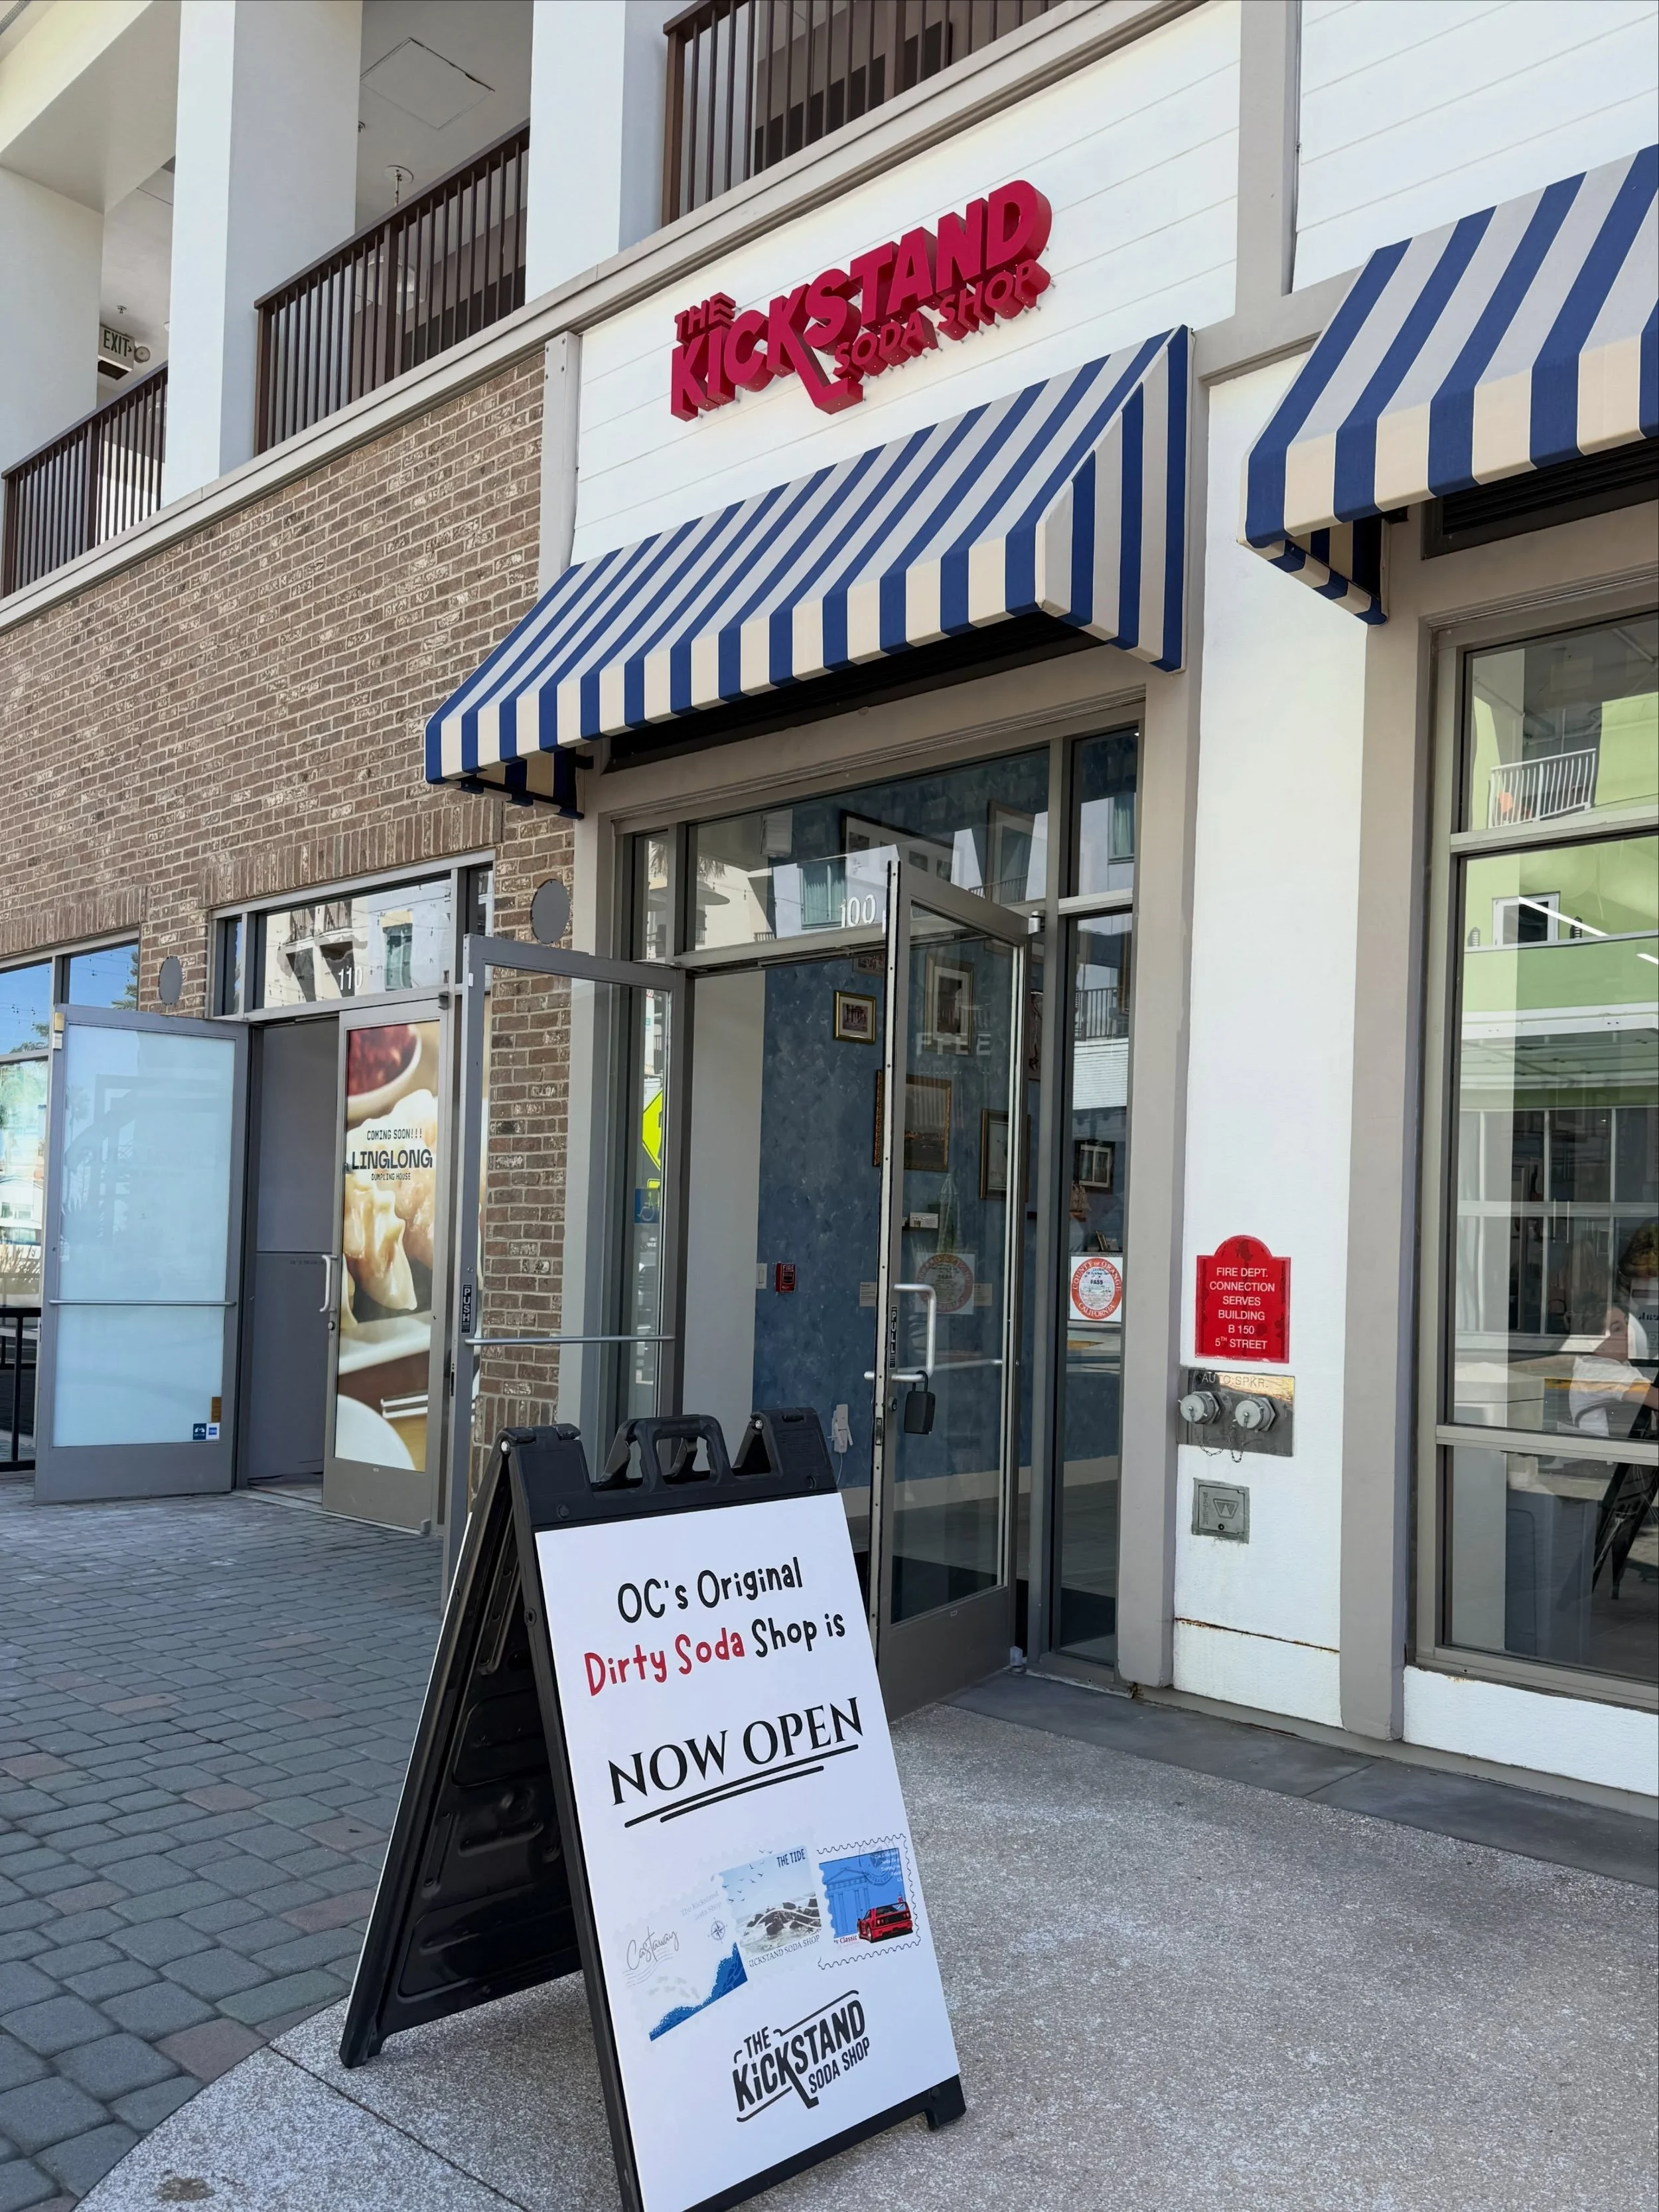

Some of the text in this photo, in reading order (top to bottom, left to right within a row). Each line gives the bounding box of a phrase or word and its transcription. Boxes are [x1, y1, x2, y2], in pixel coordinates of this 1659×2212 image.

[671, 180, 1052, 421] KICKSTAND
[674, 292, 736, 343] THE
[833, 259, 1051, 381] SODA SHOP
[104, 329, 130, 357] EXIT
[839, 894, 876, 928] 100
[338, 966, 363, 991] 110
[367, 1128, 422, 1140] COMING SOON!!!
[352, 1149, 433, 1170] LINGLONG
[1072, 1261, 1092, 1290] COUNTY
[1102, 1261, 1121, 1291] ORANGE
[1216, 1267, 1268, 1278] FIRE DEPT.
[1209, 1281, 1275, 1292] CONNECTION
[463, 1288, 471, 1322] PUSH
[1078, 1302, 1116, 1317] CALIFORNIA
[1222, 1295, 1262, 1306] SERVES
[1218, 1309, 1265, 1321] BUILDING
[1228, 1324, 1255, 1335] B 150
[1214, 1336, 1268, 1350] 5TH STREET
[617, 1556, 803, 1623] OC's Original
[584, 1613, 846, 1696] Dirty Soda Shop is
[608, 1697, 863, 1806] NOW OPEN
[776, 1849, 806, 1868] THE TIDE
[626, 1925, 680, 1970] Castaway
[784, 1943, 802, 1954] SODA
[802, 1934, 820, 1947] SHOP
[839, 1935, 857, 1944] Classic
[743, 2026, 772, 2059] THE
[808, 2037, 870, 2094] SODA SHOP
